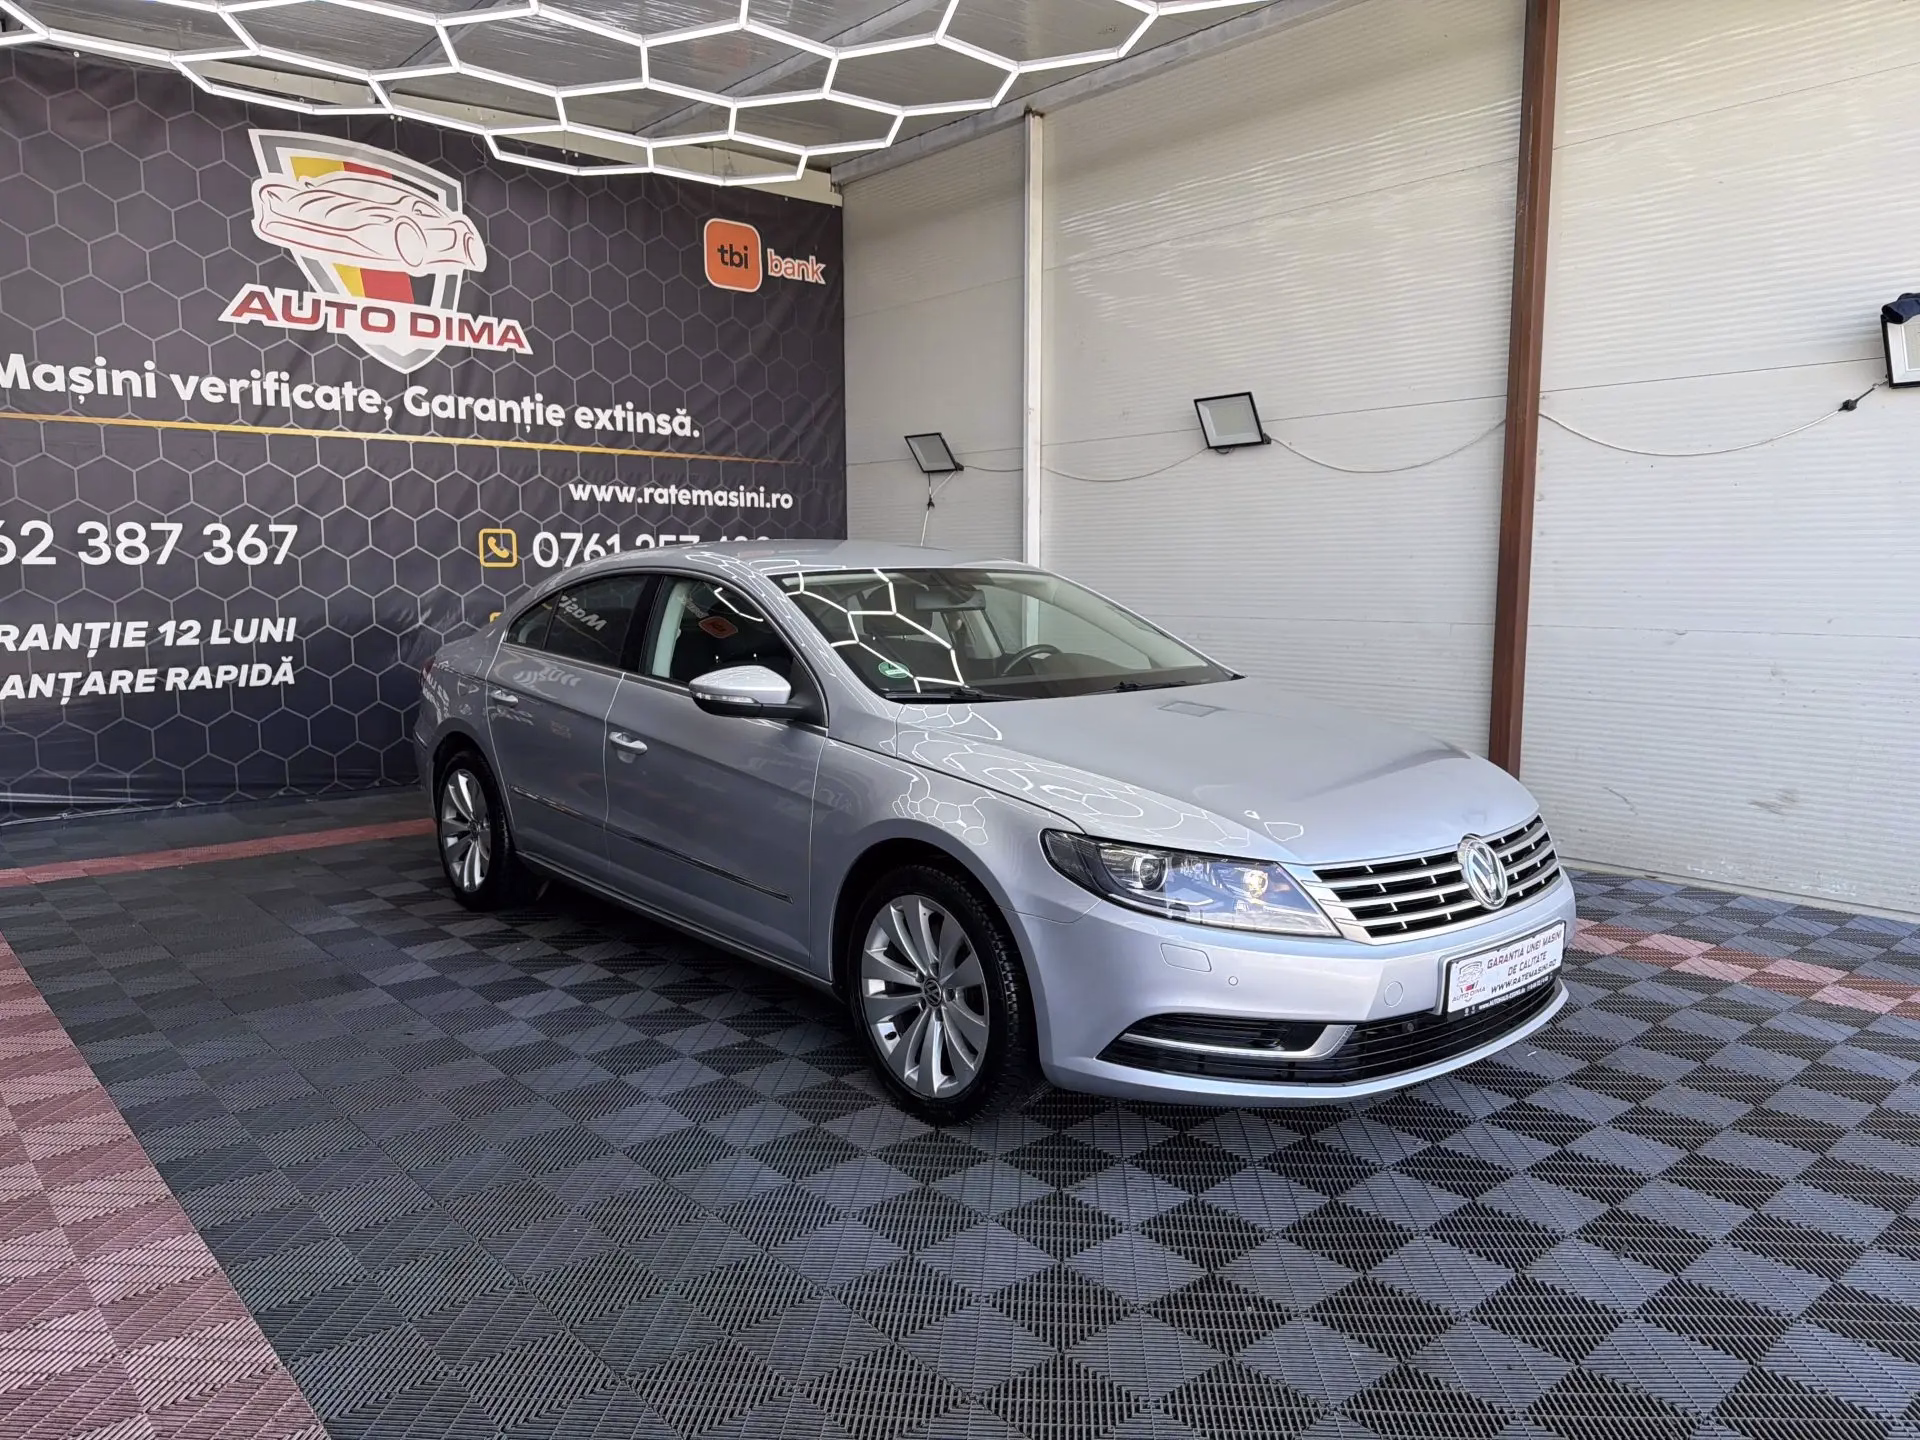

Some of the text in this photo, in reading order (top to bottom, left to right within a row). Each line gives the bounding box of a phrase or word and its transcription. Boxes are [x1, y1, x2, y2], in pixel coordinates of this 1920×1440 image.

[717, 244, 826, 284] tbi bank
[231, 290, 526, 348] AUTO DIMA
[169, 367, 393, 421] verificate,
[403, 385, 565, 433] Garanție
[574, 401, 700, 438] extinsă.
[568, 483, 794, 509] www.ratemasini.ro
[77, 521, 183, 565] 387
[203, 523, 298, 565] 367
[157, 619, 202, 647] 12
[210, 617, 297, 645] LUNI
[165, 656, 295, 692] RAPIDĂ
[1487, 947, 1524, 969] GARANTIA
[1508, 964, 1518, 977] DE
